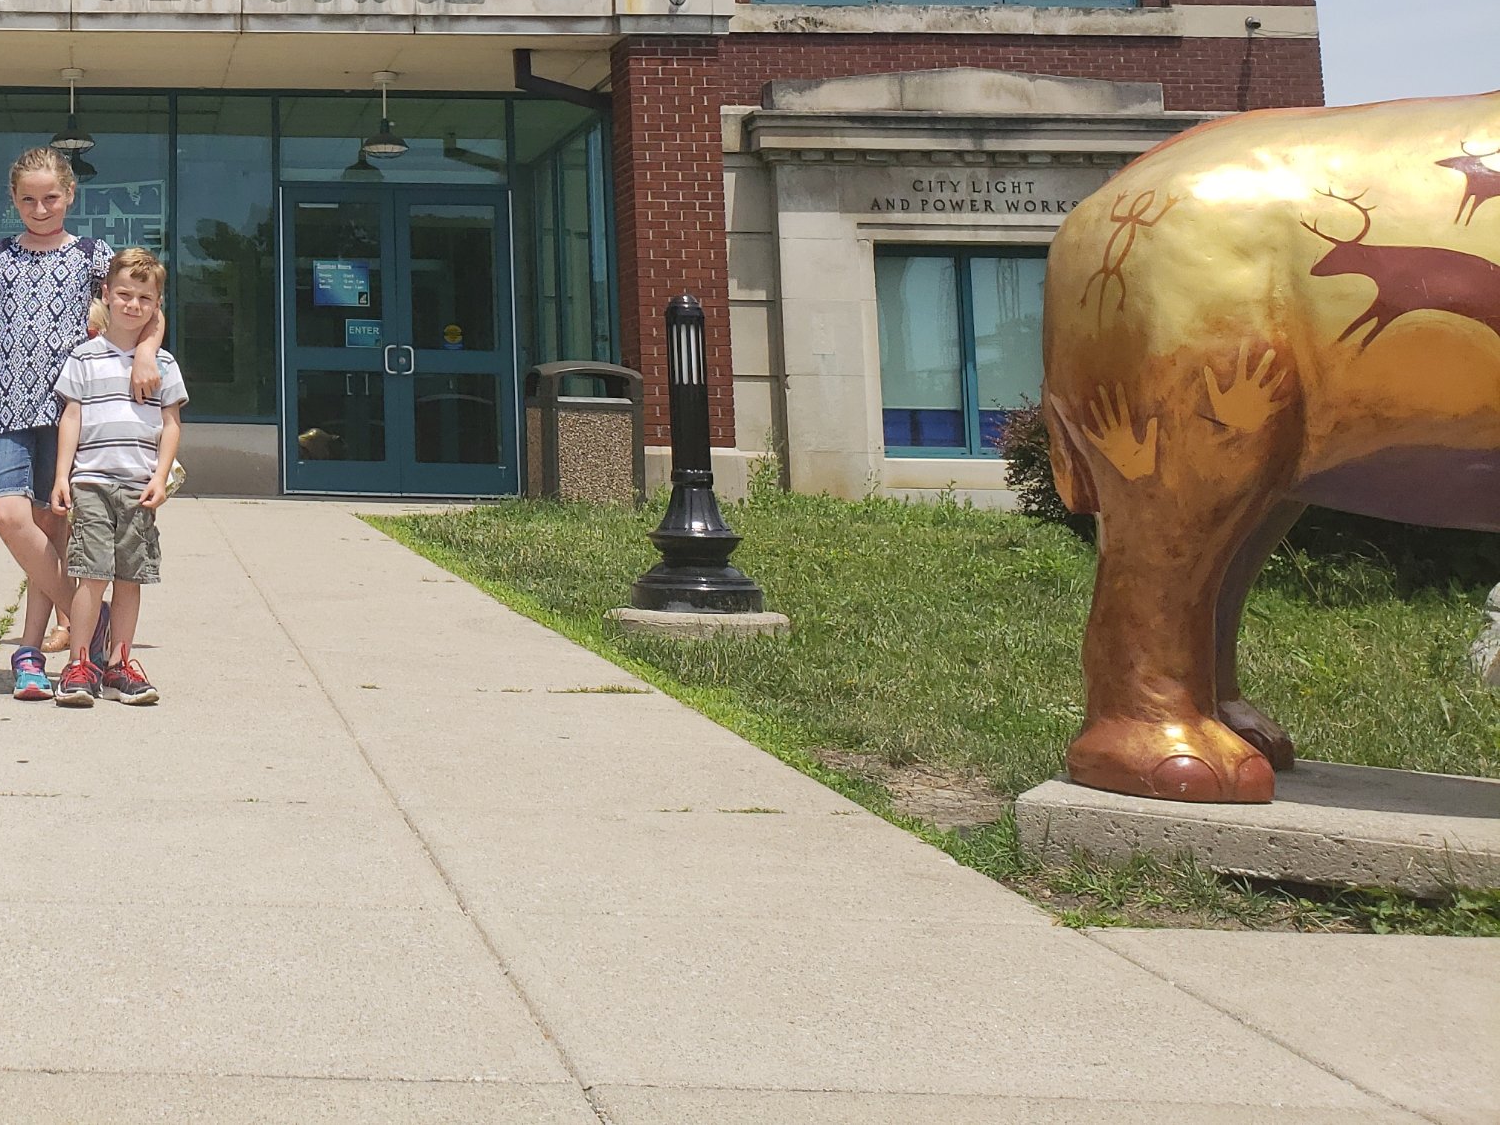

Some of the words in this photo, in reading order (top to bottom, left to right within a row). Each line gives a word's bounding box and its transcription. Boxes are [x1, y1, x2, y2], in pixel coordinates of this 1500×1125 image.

[912, 179, 961, 193] CITY
[971, 181, 1036, 194] LIGHT
[870, 198, 911, 211] AND
[921, 199, 996, 212] POWER
[1005, 199, 1080, 213] WORKS
[349, 326, 380, 335] ENTER
